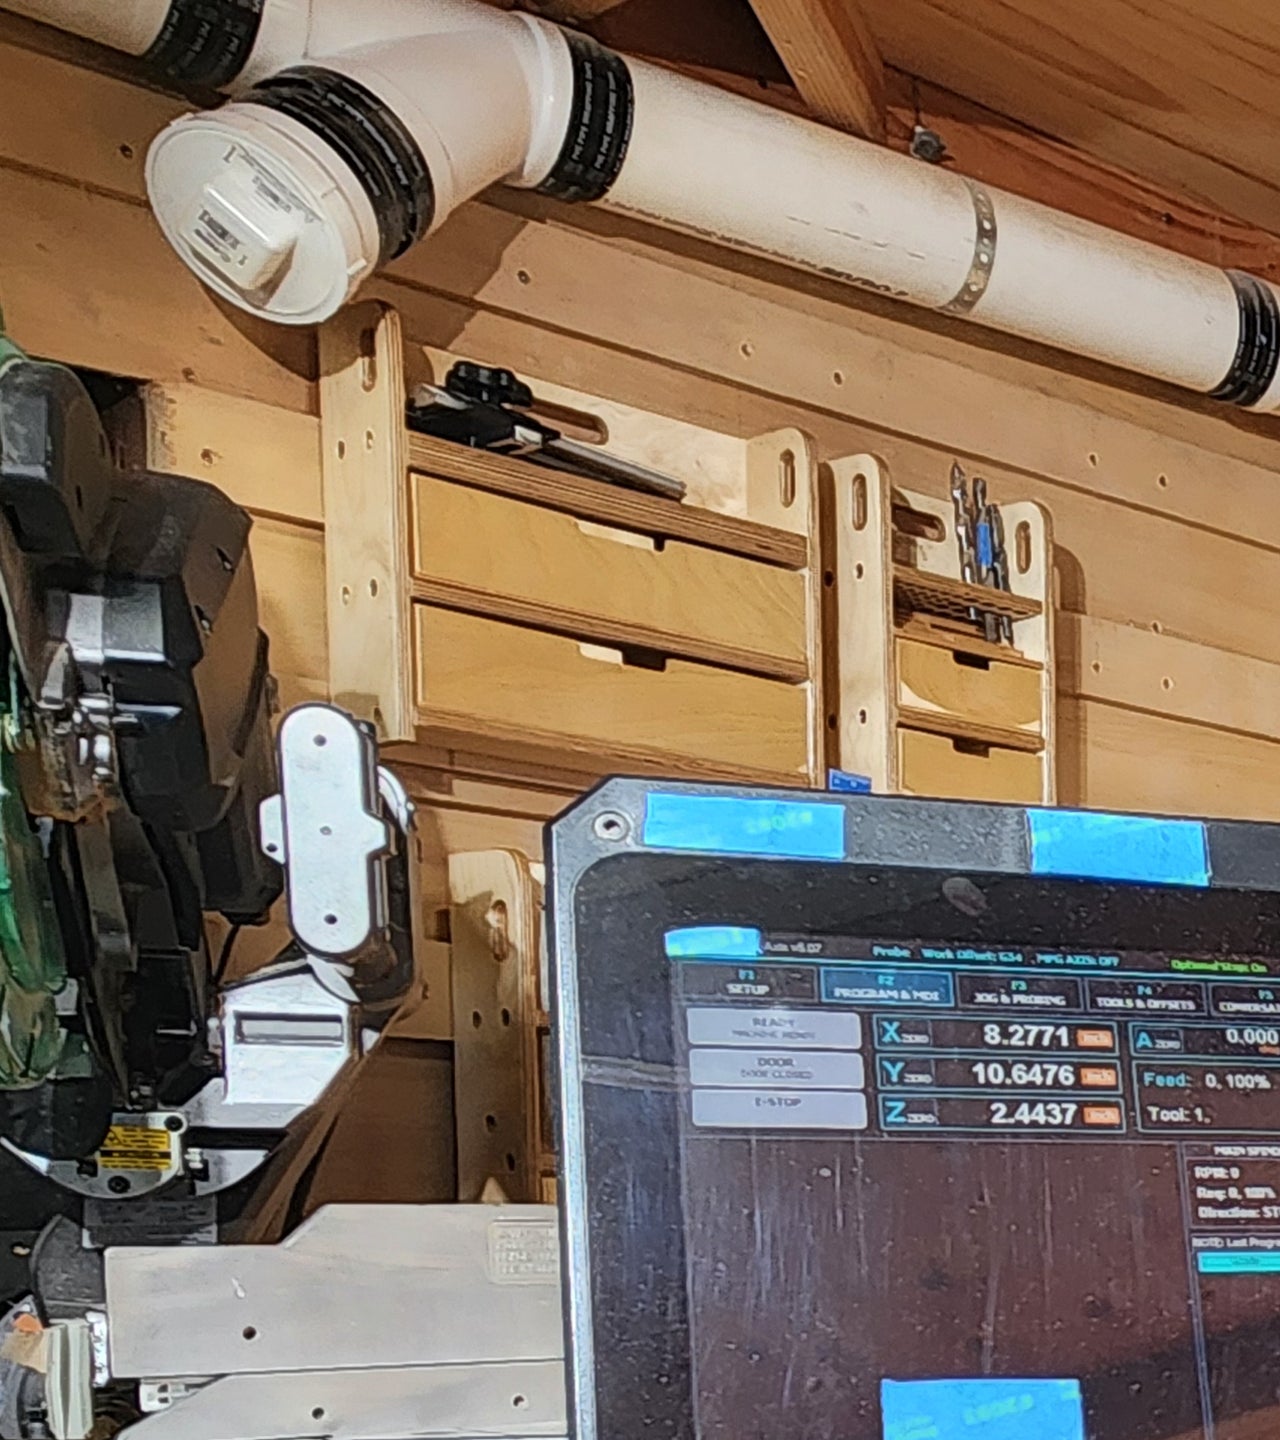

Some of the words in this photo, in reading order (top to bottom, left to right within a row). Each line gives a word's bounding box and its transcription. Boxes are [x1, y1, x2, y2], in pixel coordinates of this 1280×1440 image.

[872, 944, 911, 958] Probe
[921, 947, 954, 960] Work
[725, 982, 770, 996] SETUP
[881, 1020, 902, 1044] X
[983, 1022, 1071, 1048] 8.2771
[1135, 1030, 1154, 1050] A
[757, 1056, 795, 1068] DOOR
[881, 1059, 906, 1084] Y
[971, 1061, 1076, 1087] 10.6476
[1142, 1071, 1193, 1088] Feed:
[1225, 1072, 1272, 1090] 100%
[754, 1096, 803, 1108] E-STOP
[884, 1100, 907, 1124] Z
[988, 1101, 1079, 1126] 2.4437
[1146, 1104, 1192, 1123] Tool:
